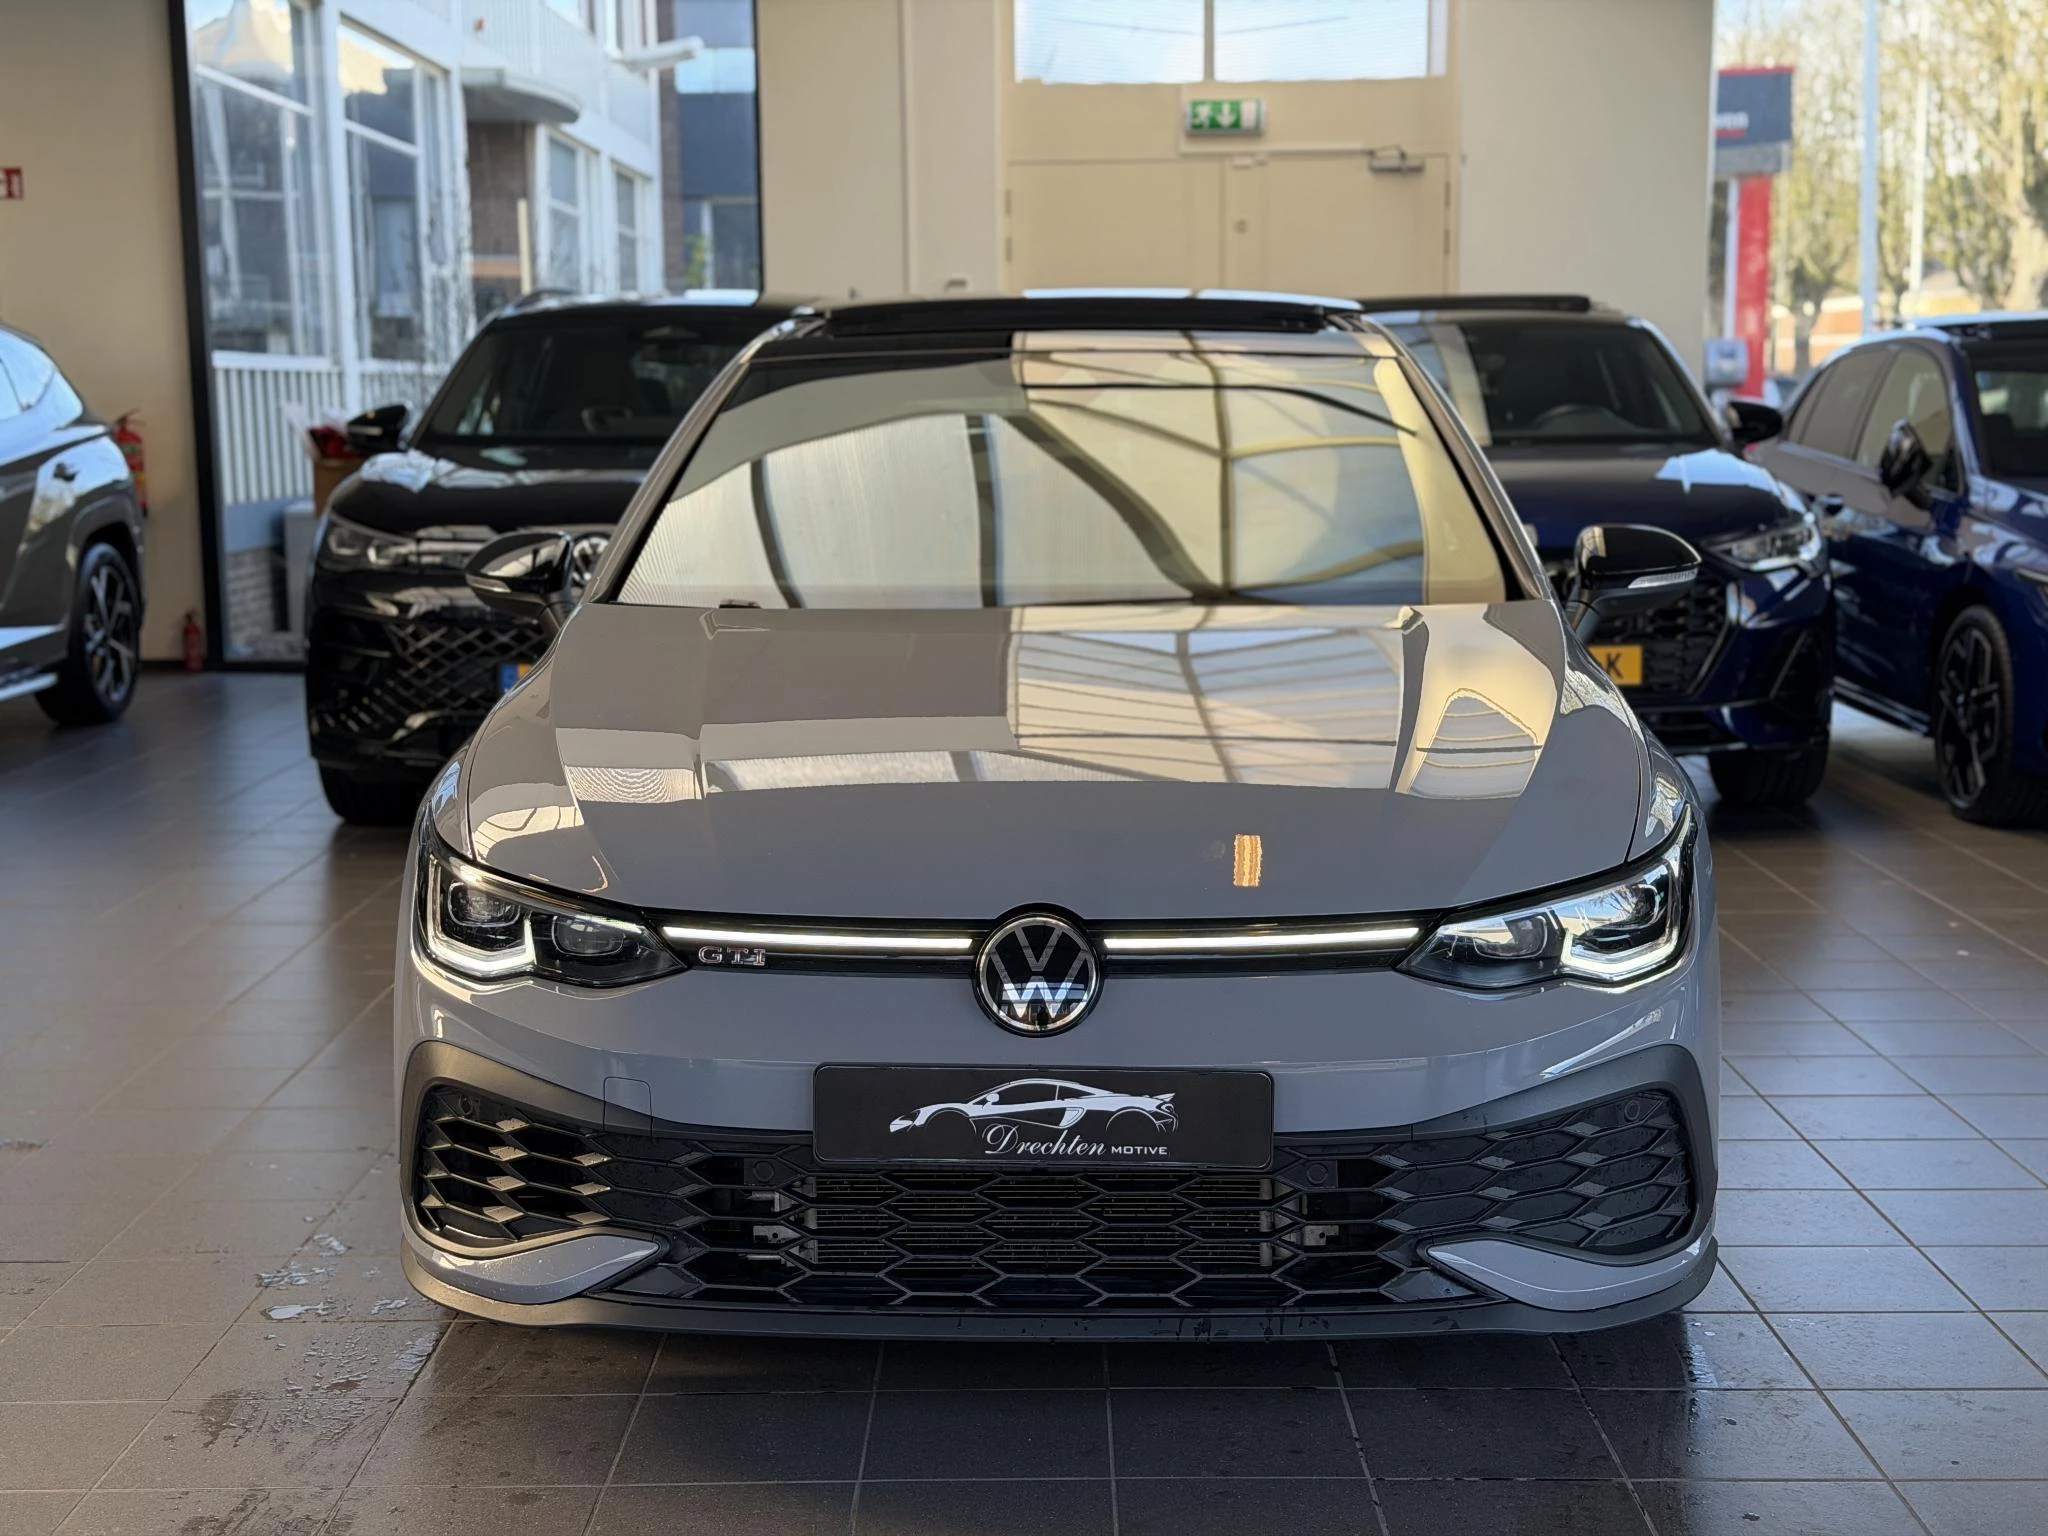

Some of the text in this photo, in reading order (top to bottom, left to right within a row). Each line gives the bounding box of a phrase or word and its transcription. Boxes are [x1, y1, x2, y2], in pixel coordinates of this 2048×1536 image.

[698, 946, 766, 967] GTI
[982, 1123, 1168, 1155] Drechten MOTIVE
